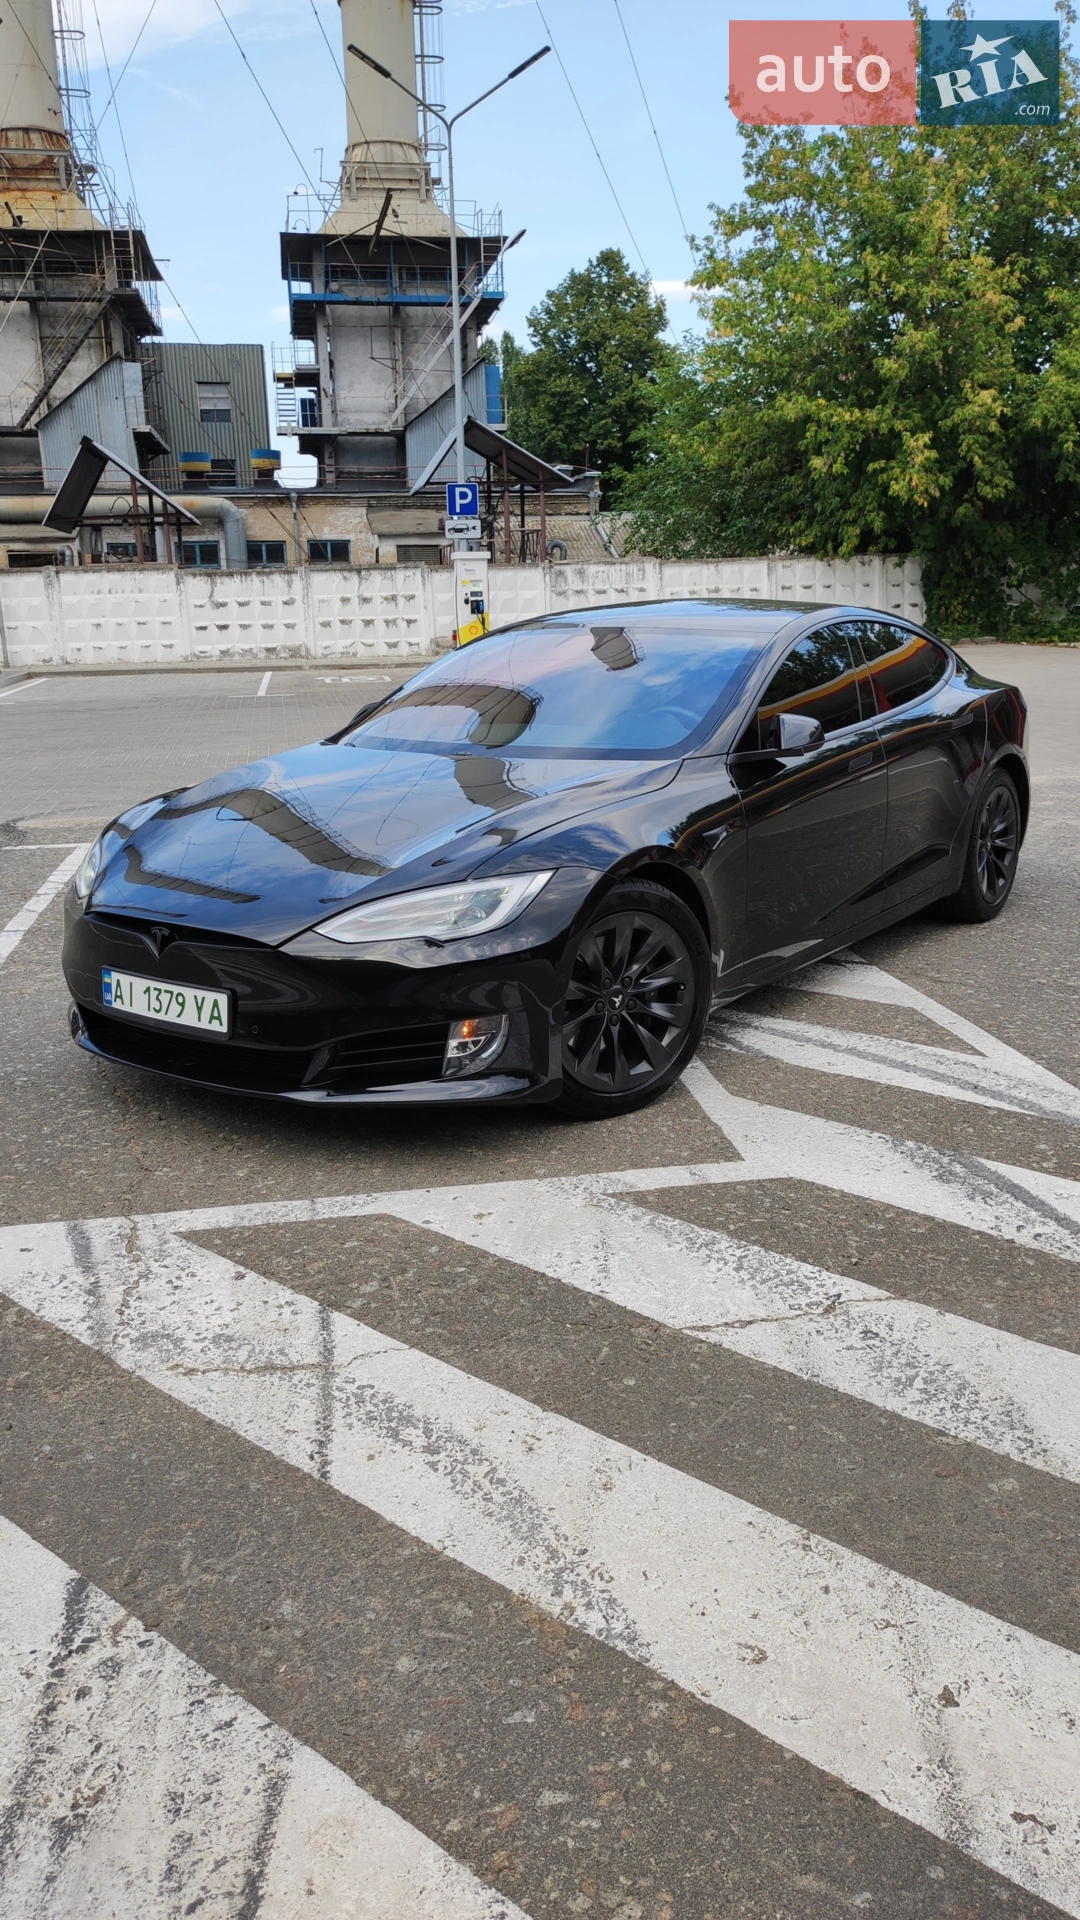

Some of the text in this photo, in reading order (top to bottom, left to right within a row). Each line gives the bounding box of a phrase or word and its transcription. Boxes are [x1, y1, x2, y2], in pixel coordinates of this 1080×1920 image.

[455, 487, 473, 513] P
[104, 991, 112, 1001] UA
[113, 978, 224, 1027] AI 1379 YA
